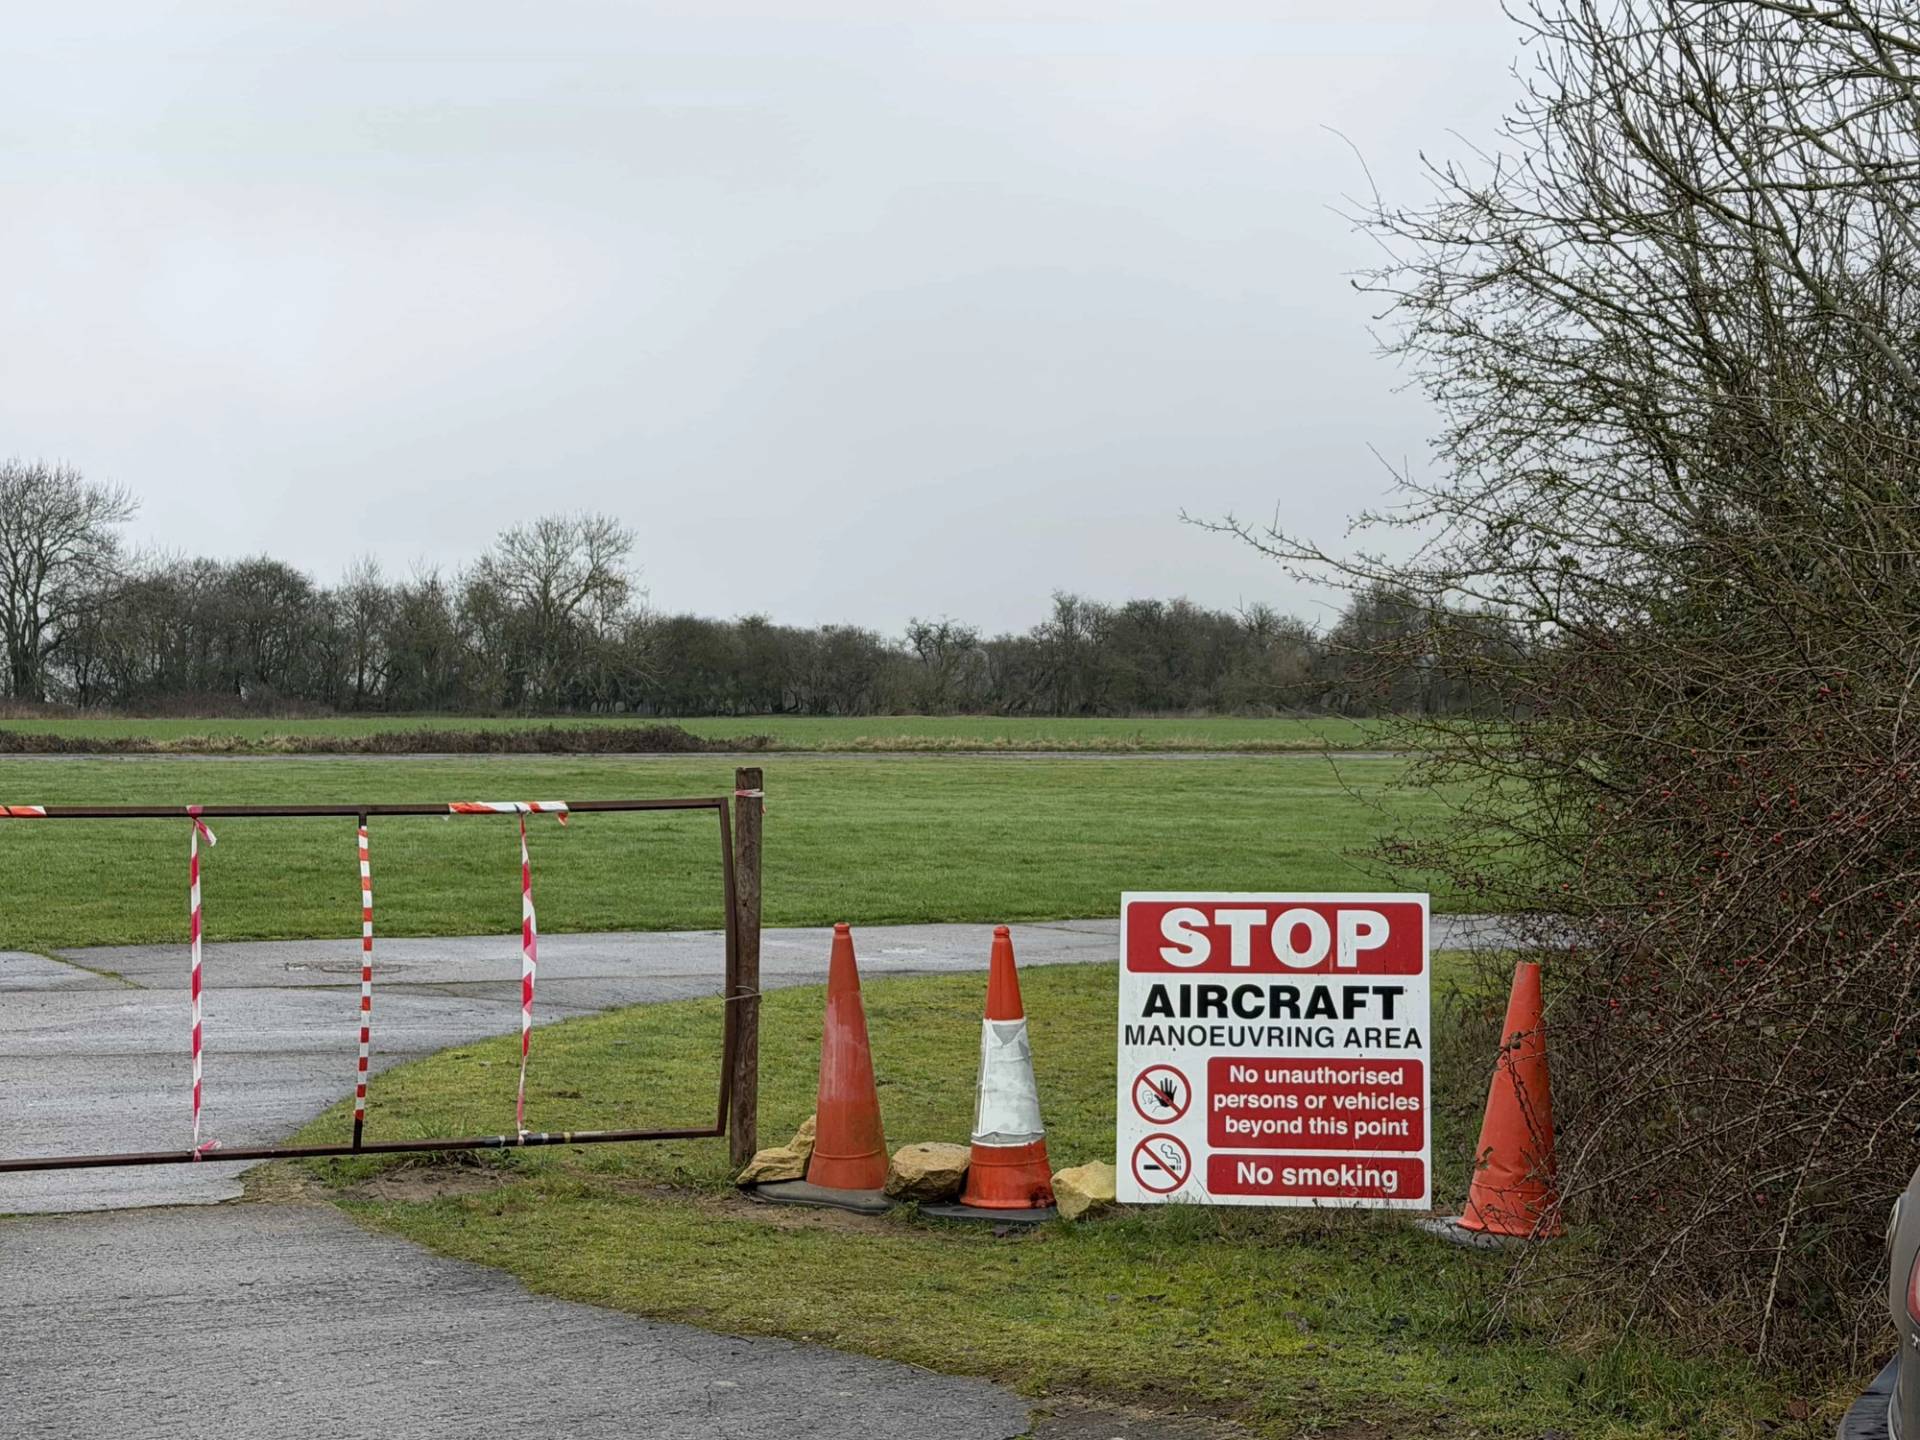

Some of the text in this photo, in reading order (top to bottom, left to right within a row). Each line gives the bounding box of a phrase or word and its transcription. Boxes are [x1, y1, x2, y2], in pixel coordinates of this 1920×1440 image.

[1159, 907, 1390, 968] STOP
[1142, 983, 1404, 1020] AIRCRAFT
[1125, 1024, 1423, 1049] MANOEUVRING AREA
[1229, 1065, 1404, 1085] No unauthorised
[1213, 1092, 1420, 1111] persons or vehicles
[1225, 1116, 1408, 1139] beyond this point
[1237, 1162, 1398, 1192] No smoking
